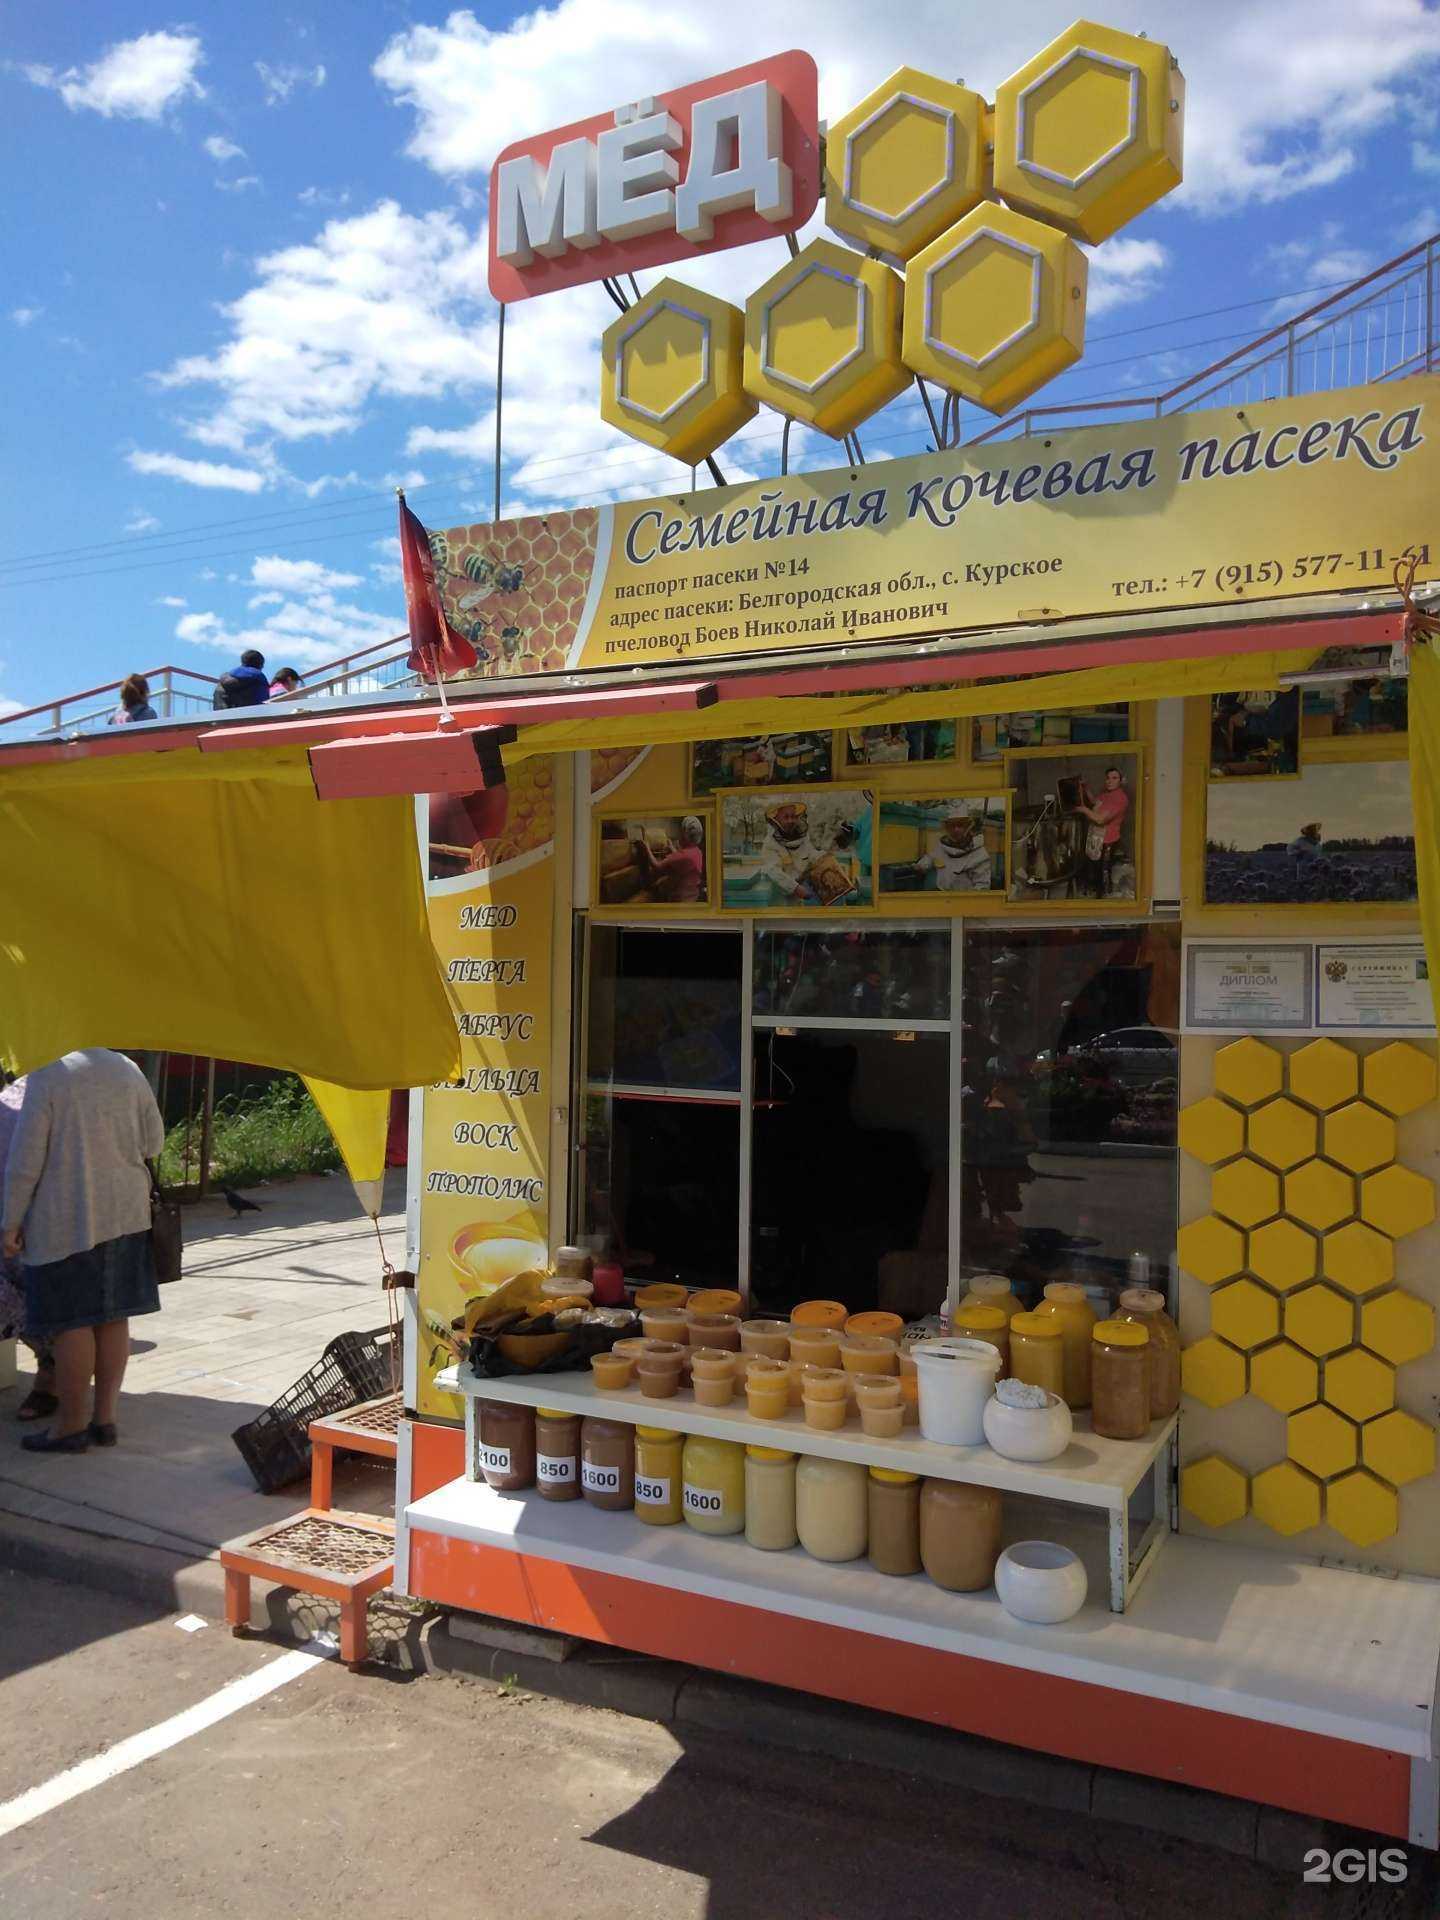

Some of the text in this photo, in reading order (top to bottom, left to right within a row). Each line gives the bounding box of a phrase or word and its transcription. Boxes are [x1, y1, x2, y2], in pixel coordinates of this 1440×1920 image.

[497, 79, 795, 270] МЁД
[624, 406, 1424, 564] Семейная кочевая пасека
[610, 557, 1063, 630] адрес пасеки: Белгородская обл., с. Курское
[614, 557, 810, 600] паспорт пасеки №14
[1112, 578, 1168, 597] тел.:
[1176, 568, 1206, 588] +7
[1215, 560, 1283, 592] (915)
[605, 600, 948, 654] пчеловод Боев Николай Иванович
[447, 958, 526, 985] ПЕРГА
[1219, 975, 1279, 986] ДИПЛОМ
[458, 1013, 533, 1041] АБРУС
[432, 1068, 541, 1098] ЫЛЬЦА
[454, 1122, 519, 1152] ВОСК
[427, 1171, 543, 1202] ПРОПОЛИС
[540, 1462, 569, 1478] 850
[582, 1468, 617, 1487] 1600
[636, 1480, 663, 1499] 850
[684, 1489, 721, 1511] 1600
